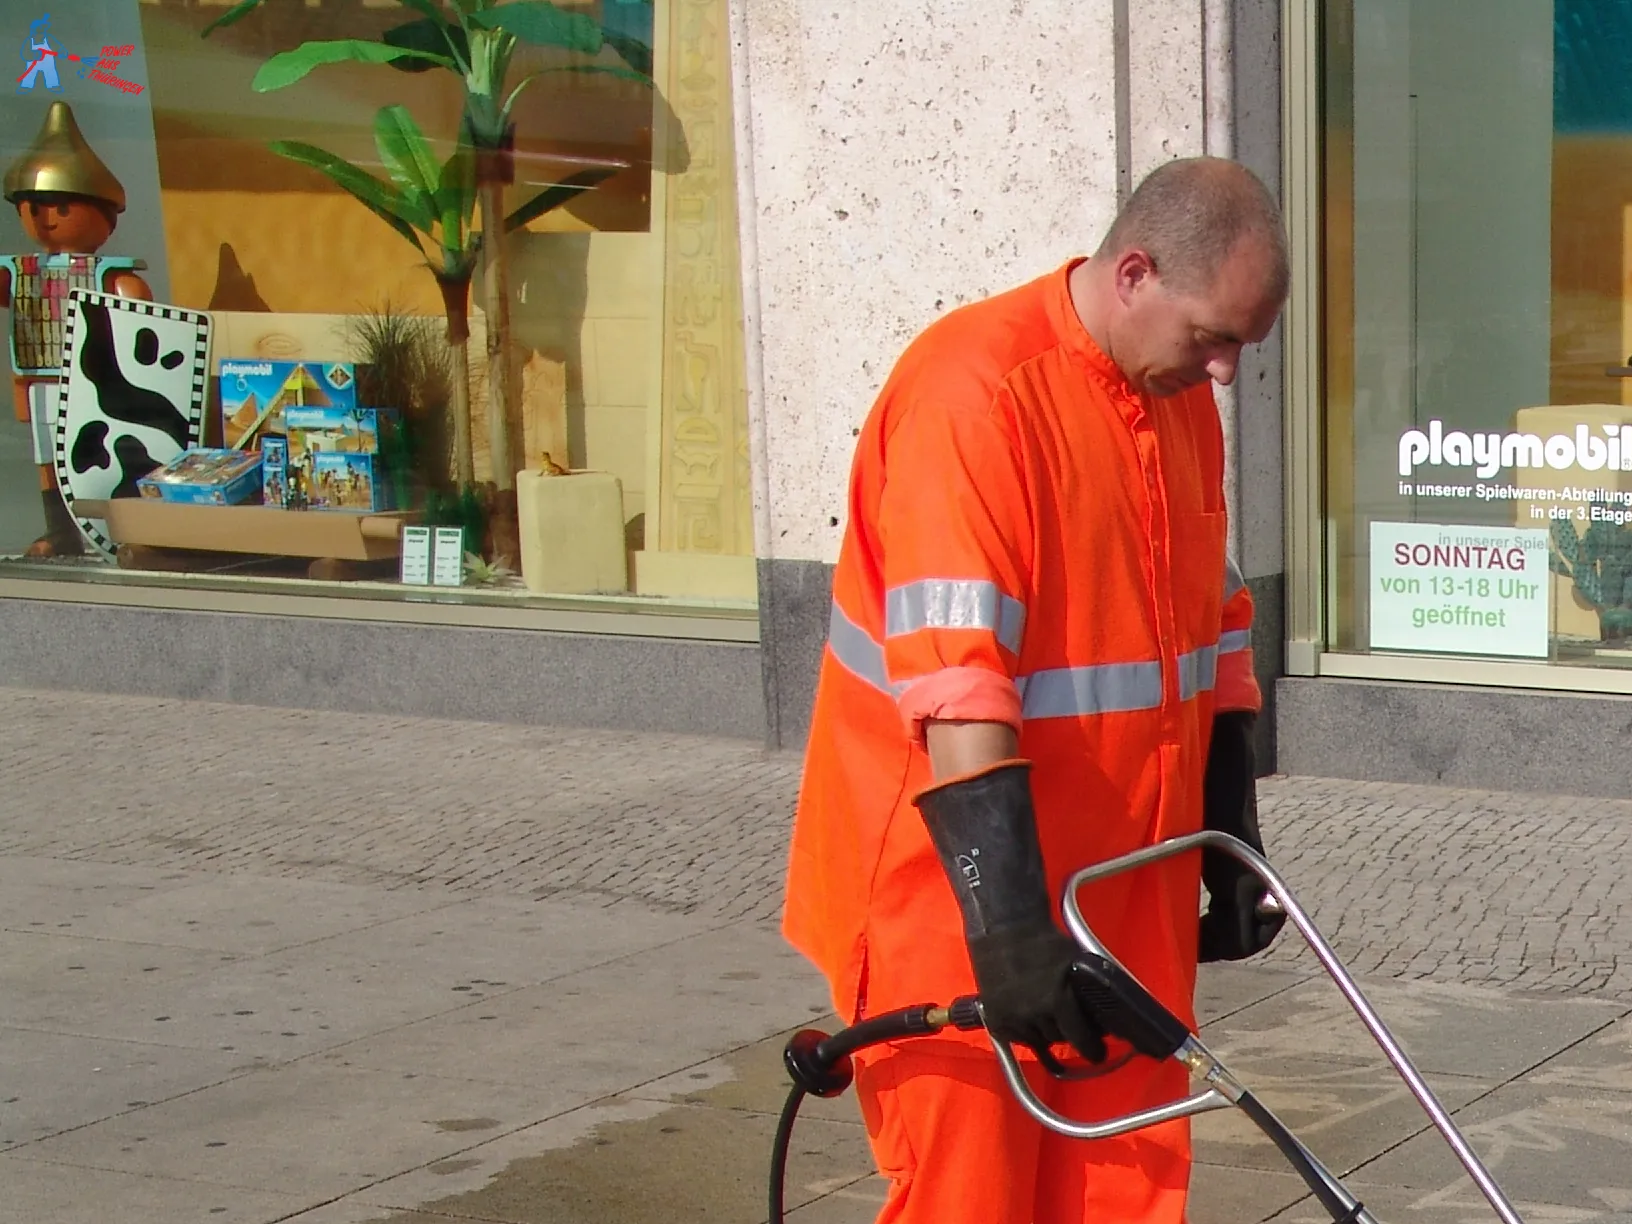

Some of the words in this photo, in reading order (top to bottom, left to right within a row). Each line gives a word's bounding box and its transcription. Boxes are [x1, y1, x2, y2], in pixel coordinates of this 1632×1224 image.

[1399, 481, 1413, 496] in
[1416, 484, 1473, 498] unserer
[1530, 504, 1545, 519] in
[1548, 504, 1573, 520] der
[1394, 542, 1526, 571] SONNTAG
[1380, 576, 1421, 594] von
[1429, 576, 1491, 598] 13-18
[1498, 579, 1539, 600] Uhr
[1412, 603, 1507, 629] geöffnet
